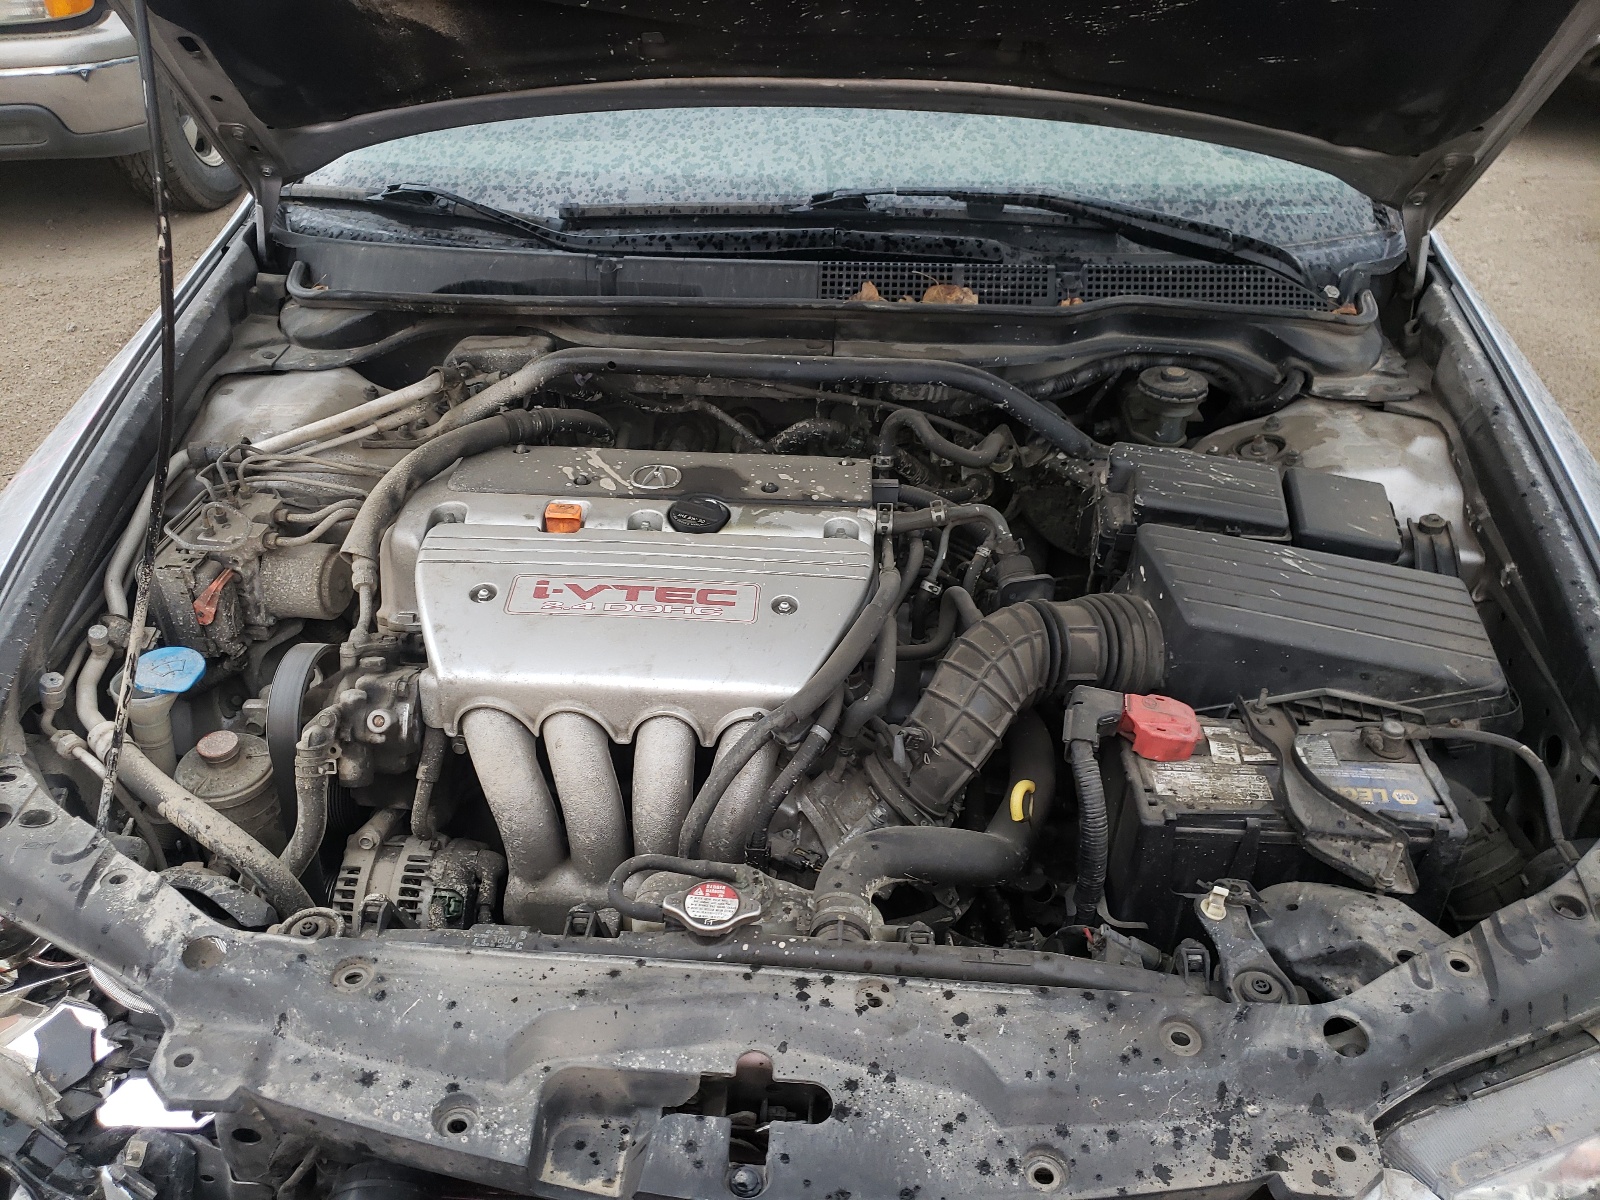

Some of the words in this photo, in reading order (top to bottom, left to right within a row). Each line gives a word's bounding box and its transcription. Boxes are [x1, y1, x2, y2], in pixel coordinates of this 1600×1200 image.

[533, 580, 737, 606] i-VTEC
[541, 601, 595, 611] 2.4
[603, 602, 723, 617] DOHC
